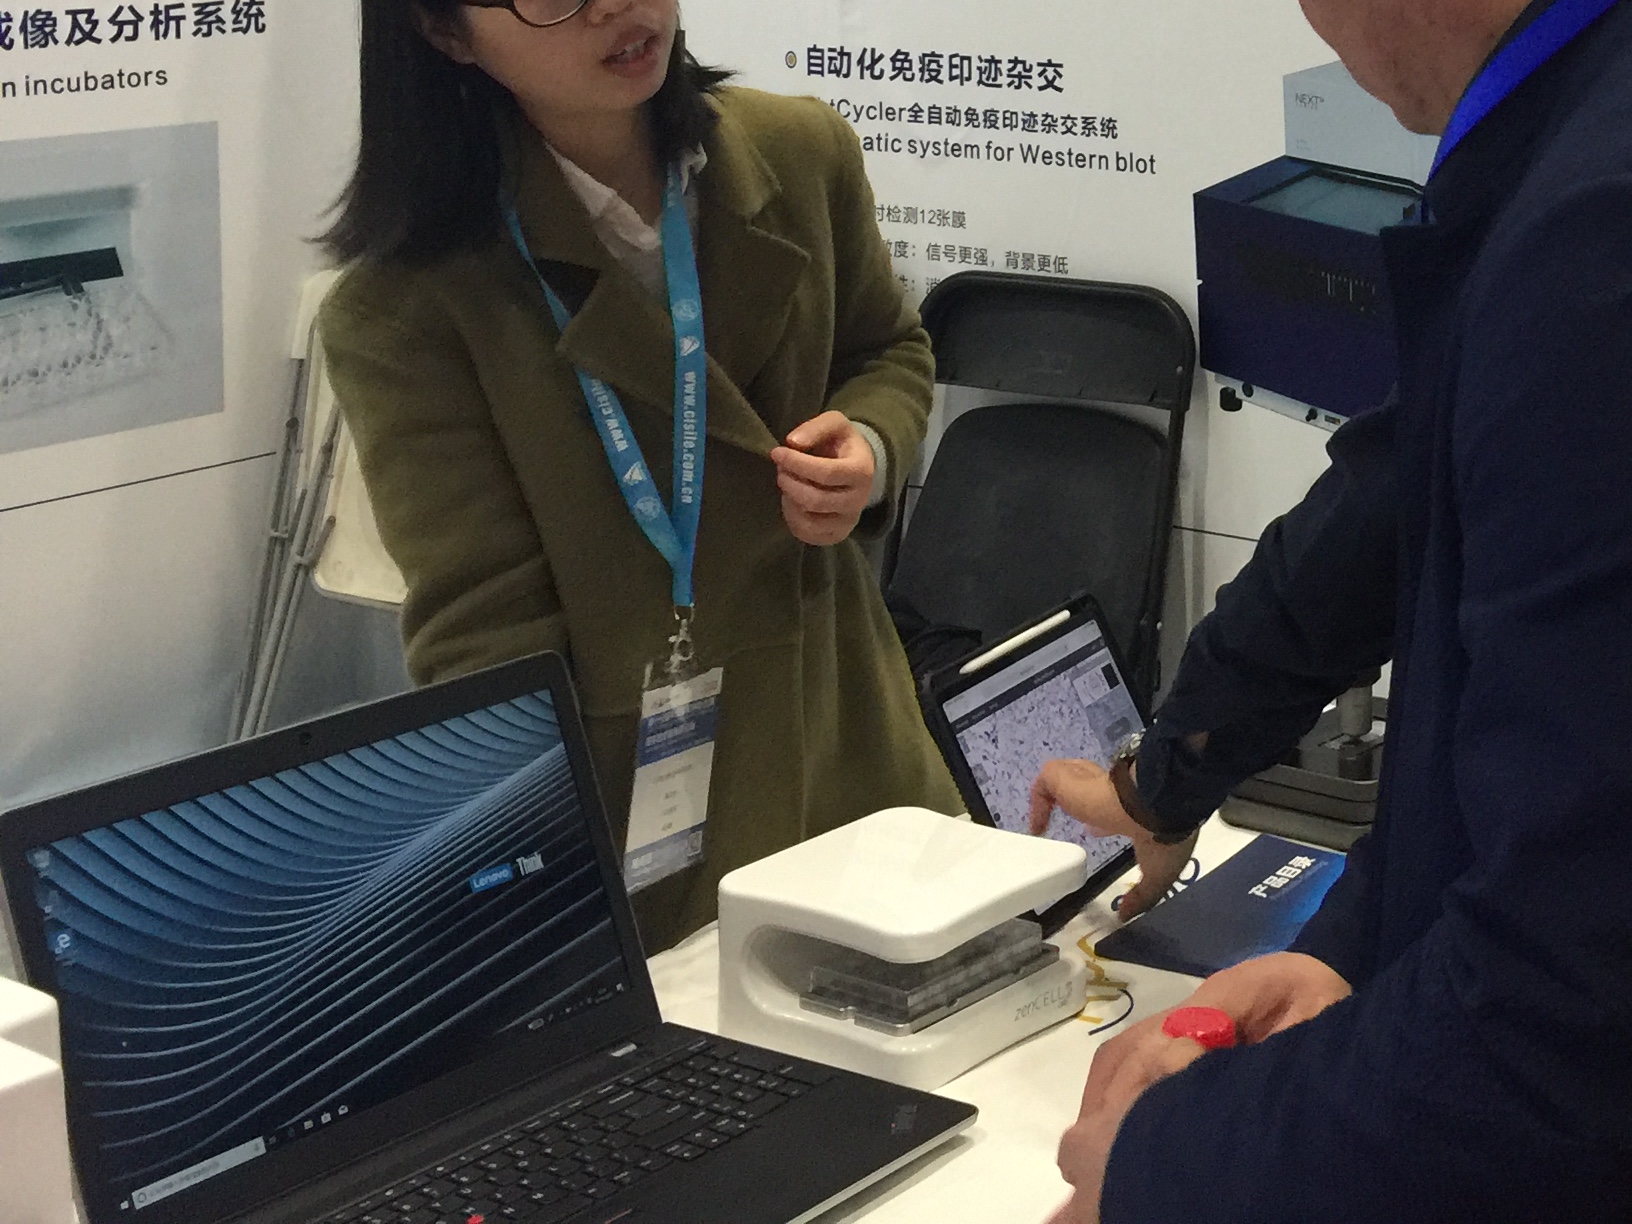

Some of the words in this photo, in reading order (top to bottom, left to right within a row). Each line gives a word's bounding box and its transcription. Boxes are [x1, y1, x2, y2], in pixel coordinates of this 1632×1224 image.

[25, 68, 168, 96] incubators
[807, 45, 1065, 93] 自动化免疫印迹杂交
[830, 97, 1119, 139] Cycler全自动免疫印迹杂交系统
[863, 132, 903, 154] atic
[908, 137, 981, 160] system
[985, 140, 1015, 163] for
[1020, 143, 1110, 171] Western
[1115, 151, 1157, 175] blot
[1248, 855, 1316, 898] 产品目录
